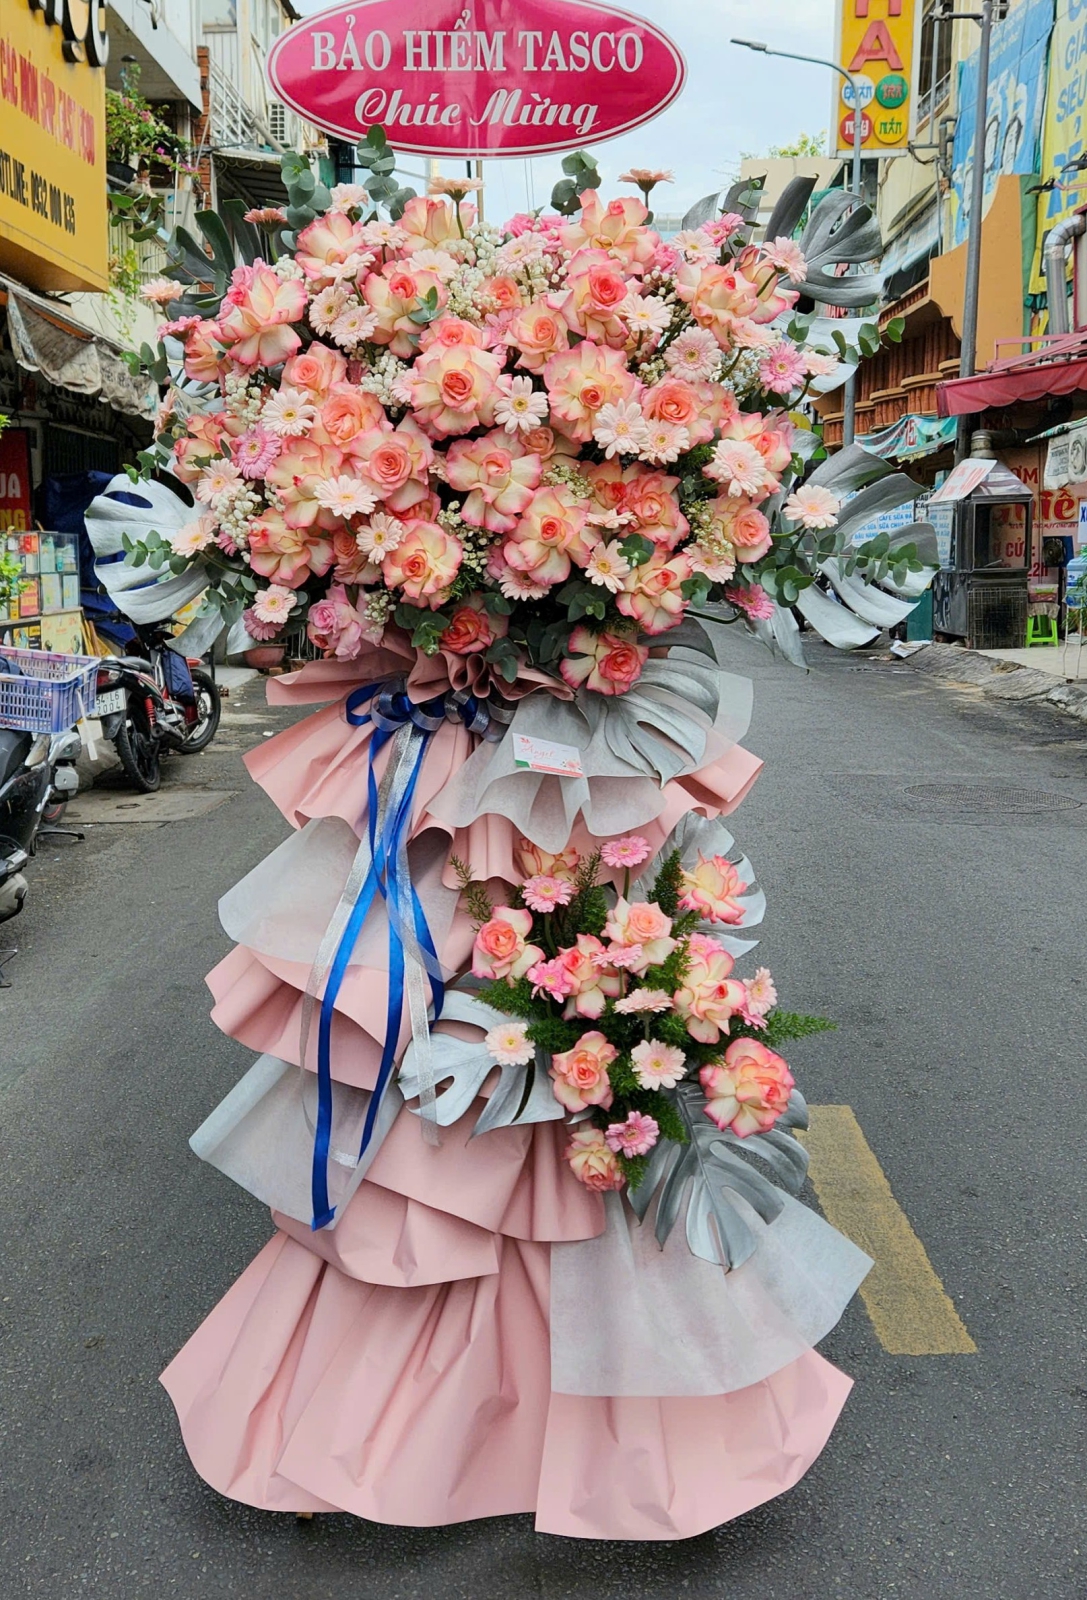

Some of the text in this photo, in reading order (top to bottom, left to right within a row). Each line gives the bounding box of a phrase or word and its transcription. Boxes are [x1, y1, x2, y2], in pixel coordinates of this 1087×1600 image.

[310, 9, 643, 72] BẢO HIỂM TASCO
[354, 88, 601, 135] Chúc Mừng
[1006, 537, 1035, 557] CỬ:
